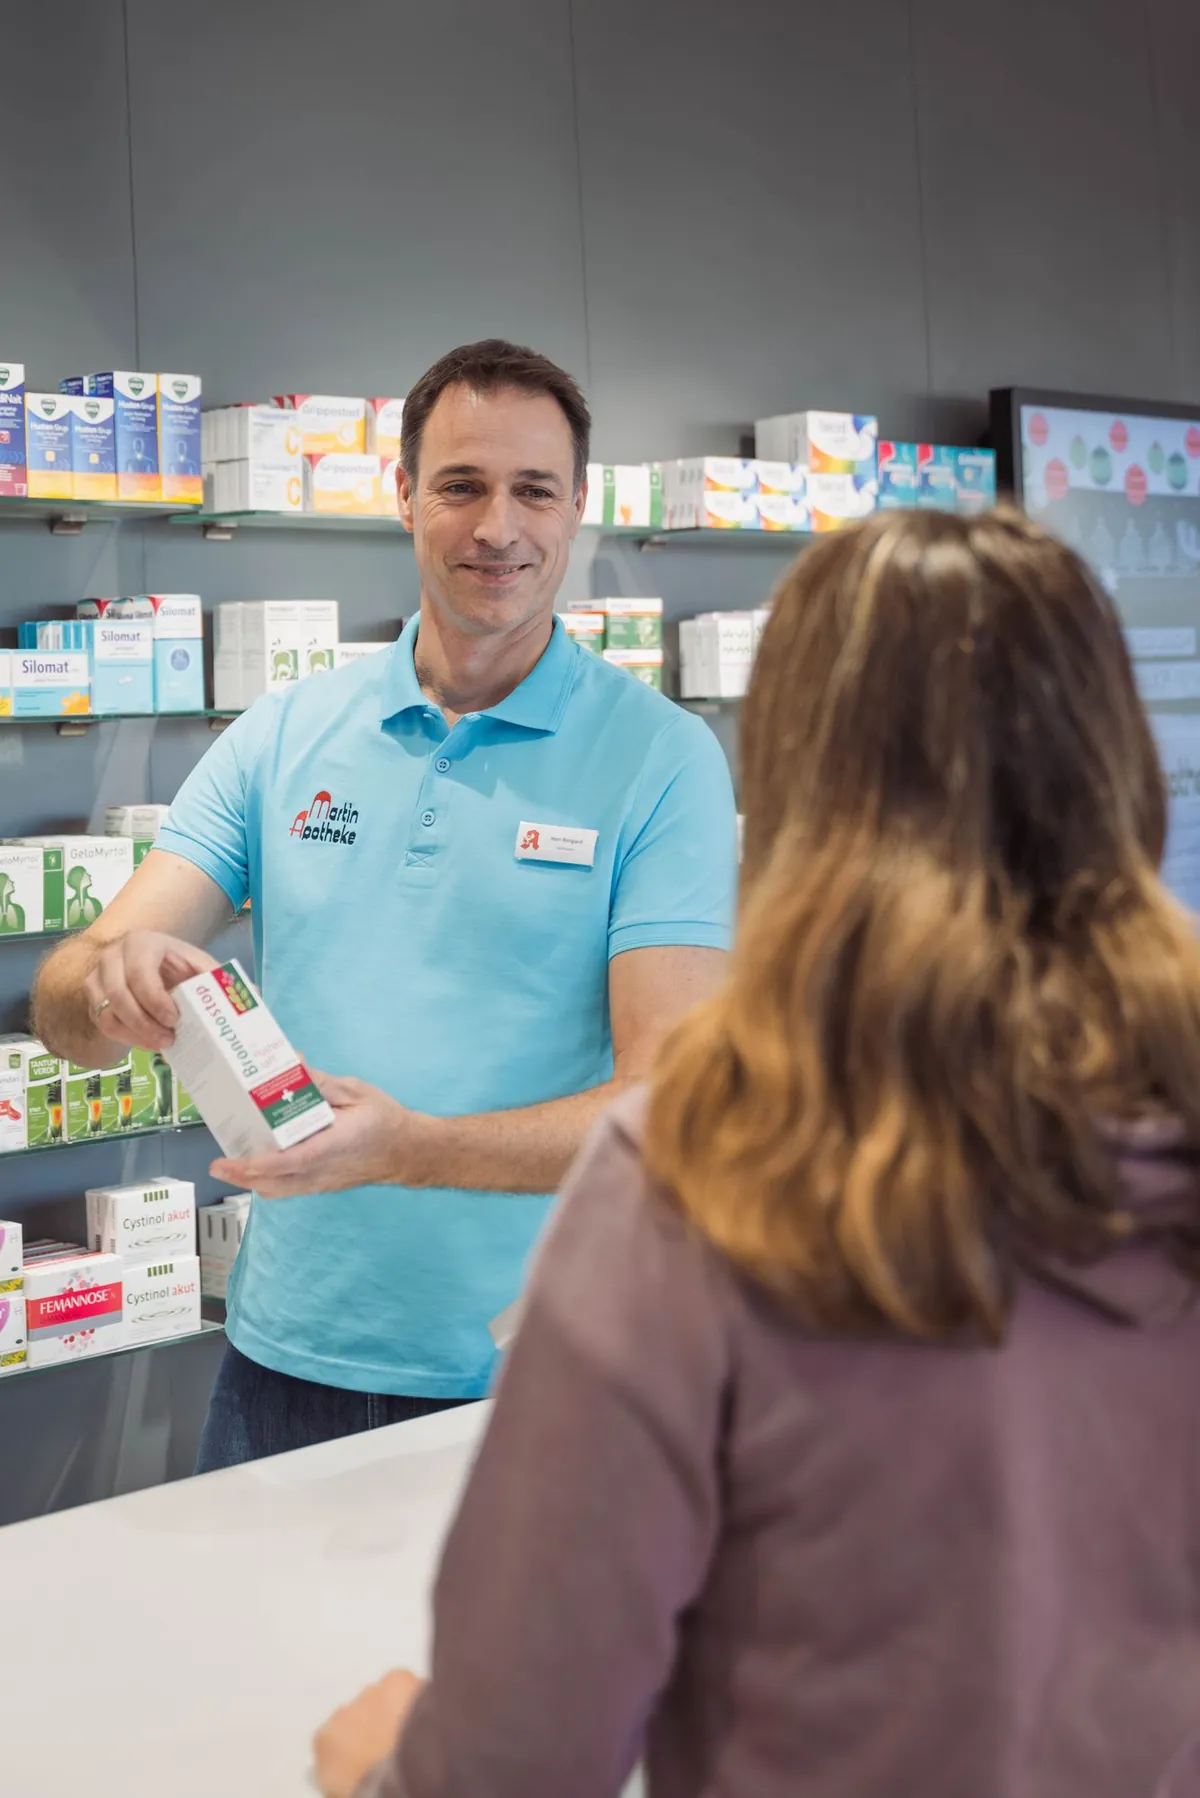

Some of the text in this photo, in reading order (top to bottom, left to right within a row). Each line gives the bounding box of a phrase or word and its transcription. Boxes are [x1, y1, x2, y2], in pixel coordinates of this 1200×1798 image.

[160, 606, 196, 617] Silomat
[101, 630, 141, 642] Silomat
[22, 659, 69, 674] Silomat
[308, 790, 359, 824] Martin
[289, 810, 357, 845] Apotheke
[0, 855, 39, 866] eloMyrtol
[70, 846, 128, 860] GeloMyrtol
[196, 984, 259, 1079] Bronchostop
[30, 1058, 58, 1068] TANTUM
[123, 1208, 190, 1231] Cystinol akut
[39, 1289, 109, 1315] FEMANNOSE
[126, 1282, 195, 1305] Cystinol akut
